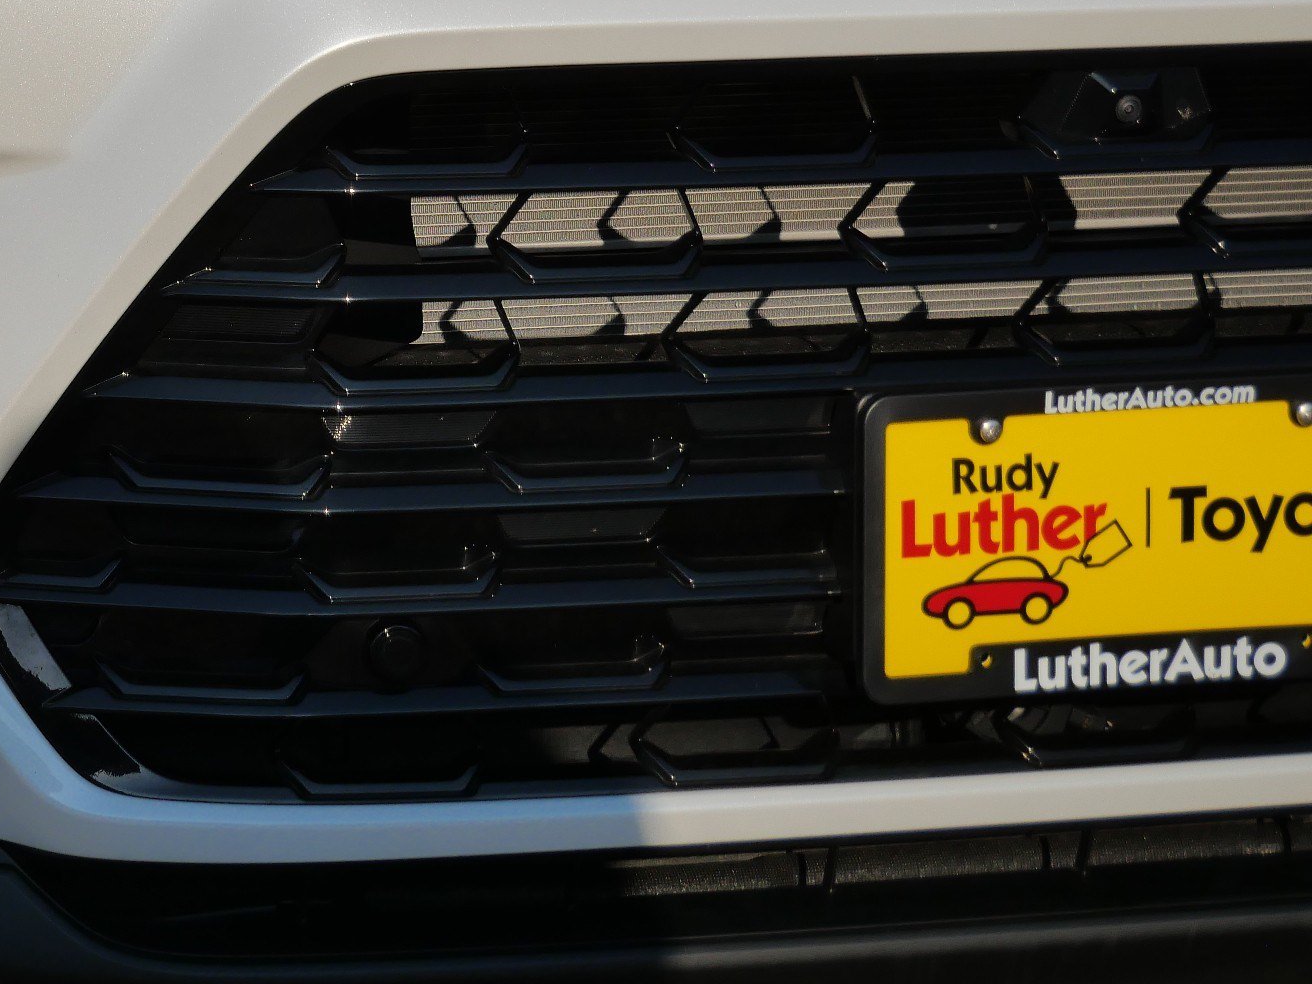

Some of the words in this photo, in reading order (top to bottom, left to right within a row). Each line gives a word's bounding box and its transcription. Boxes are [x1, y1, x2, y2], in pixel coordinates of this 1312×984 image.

[1044, 385, 1256, 414] LutherAuto.com
[951, 453, 1059, 498] Rudy
[900, 493, 1108, 559] Luther
[1168, 485, 1312, 553] Toyo
[1013, 637, 1288, 694] LutherAuto
